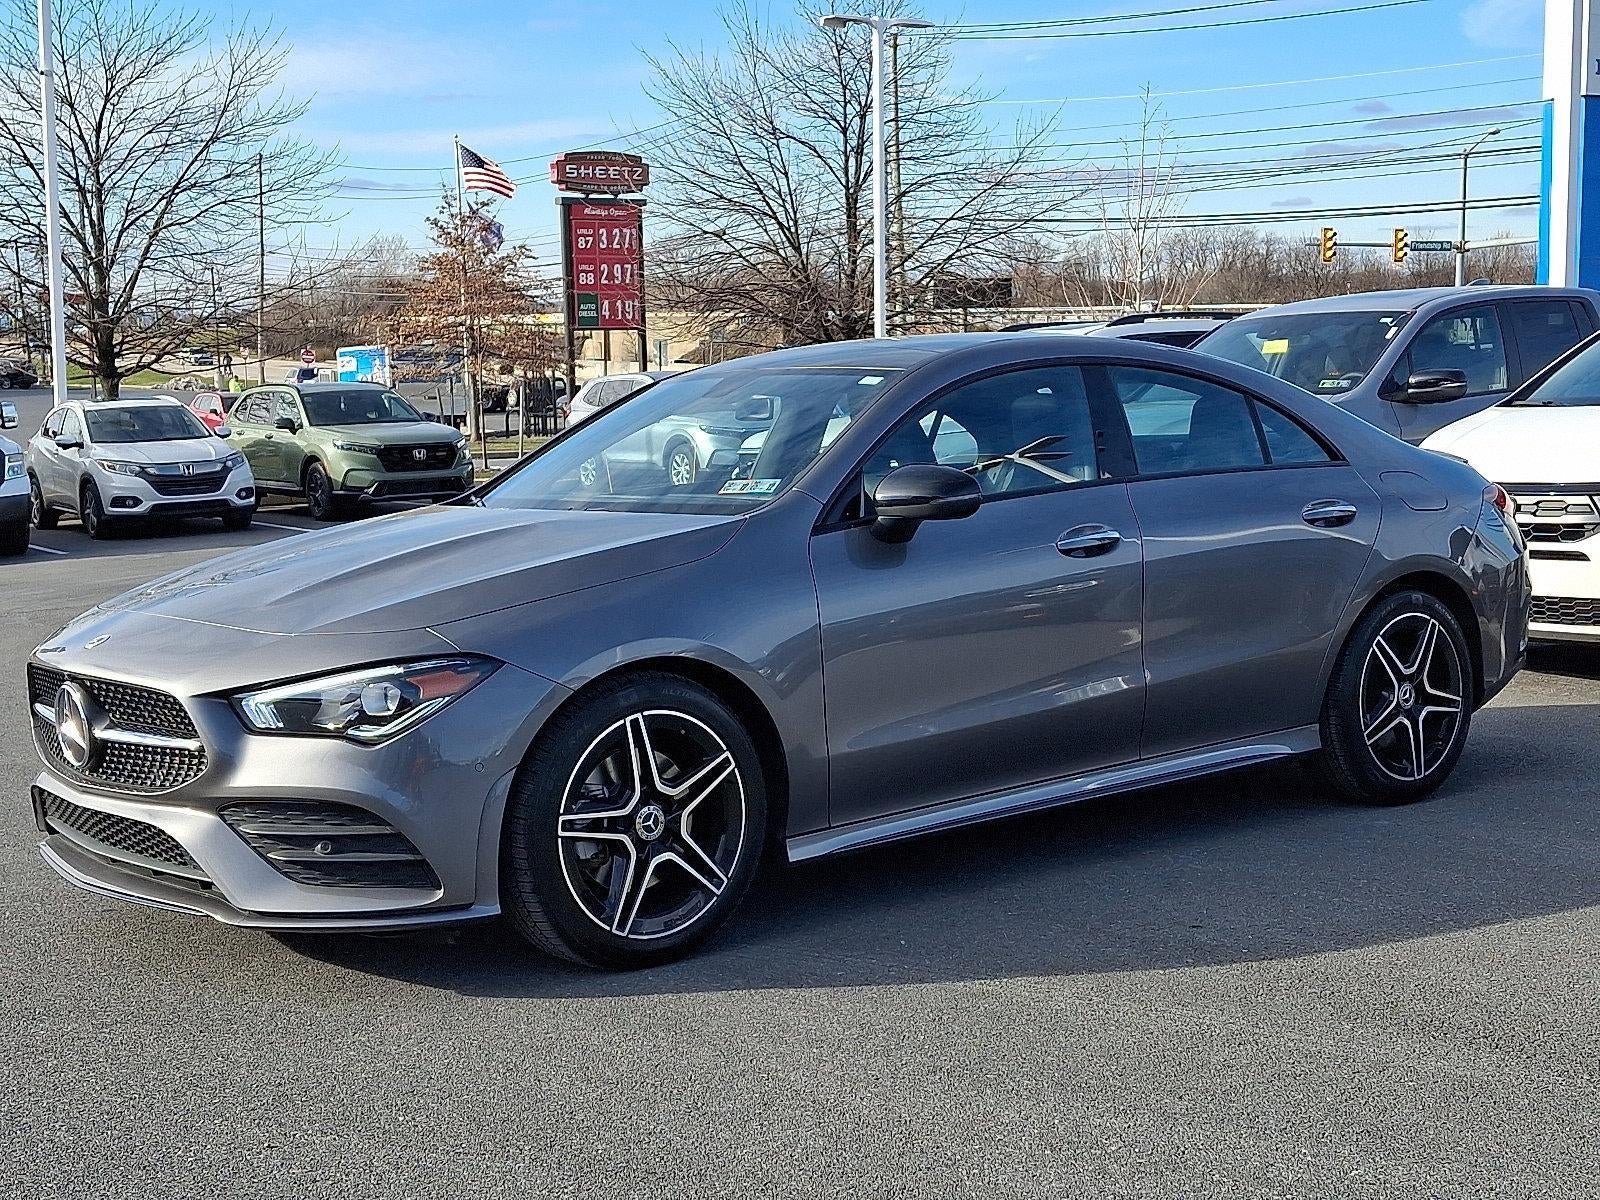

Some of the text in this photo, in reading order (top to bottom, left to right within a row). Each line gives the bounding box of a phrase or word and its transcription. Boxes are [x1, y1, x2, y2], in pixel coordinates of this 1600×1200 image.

[565, 164, 643, 180] SHEETZ
[583, 207, 608, 217] Always
[577, 236, 594, 249] 87
[1411, 241, 1451, 250] Friendship Rd
[578, 272, 595, 285] 88
